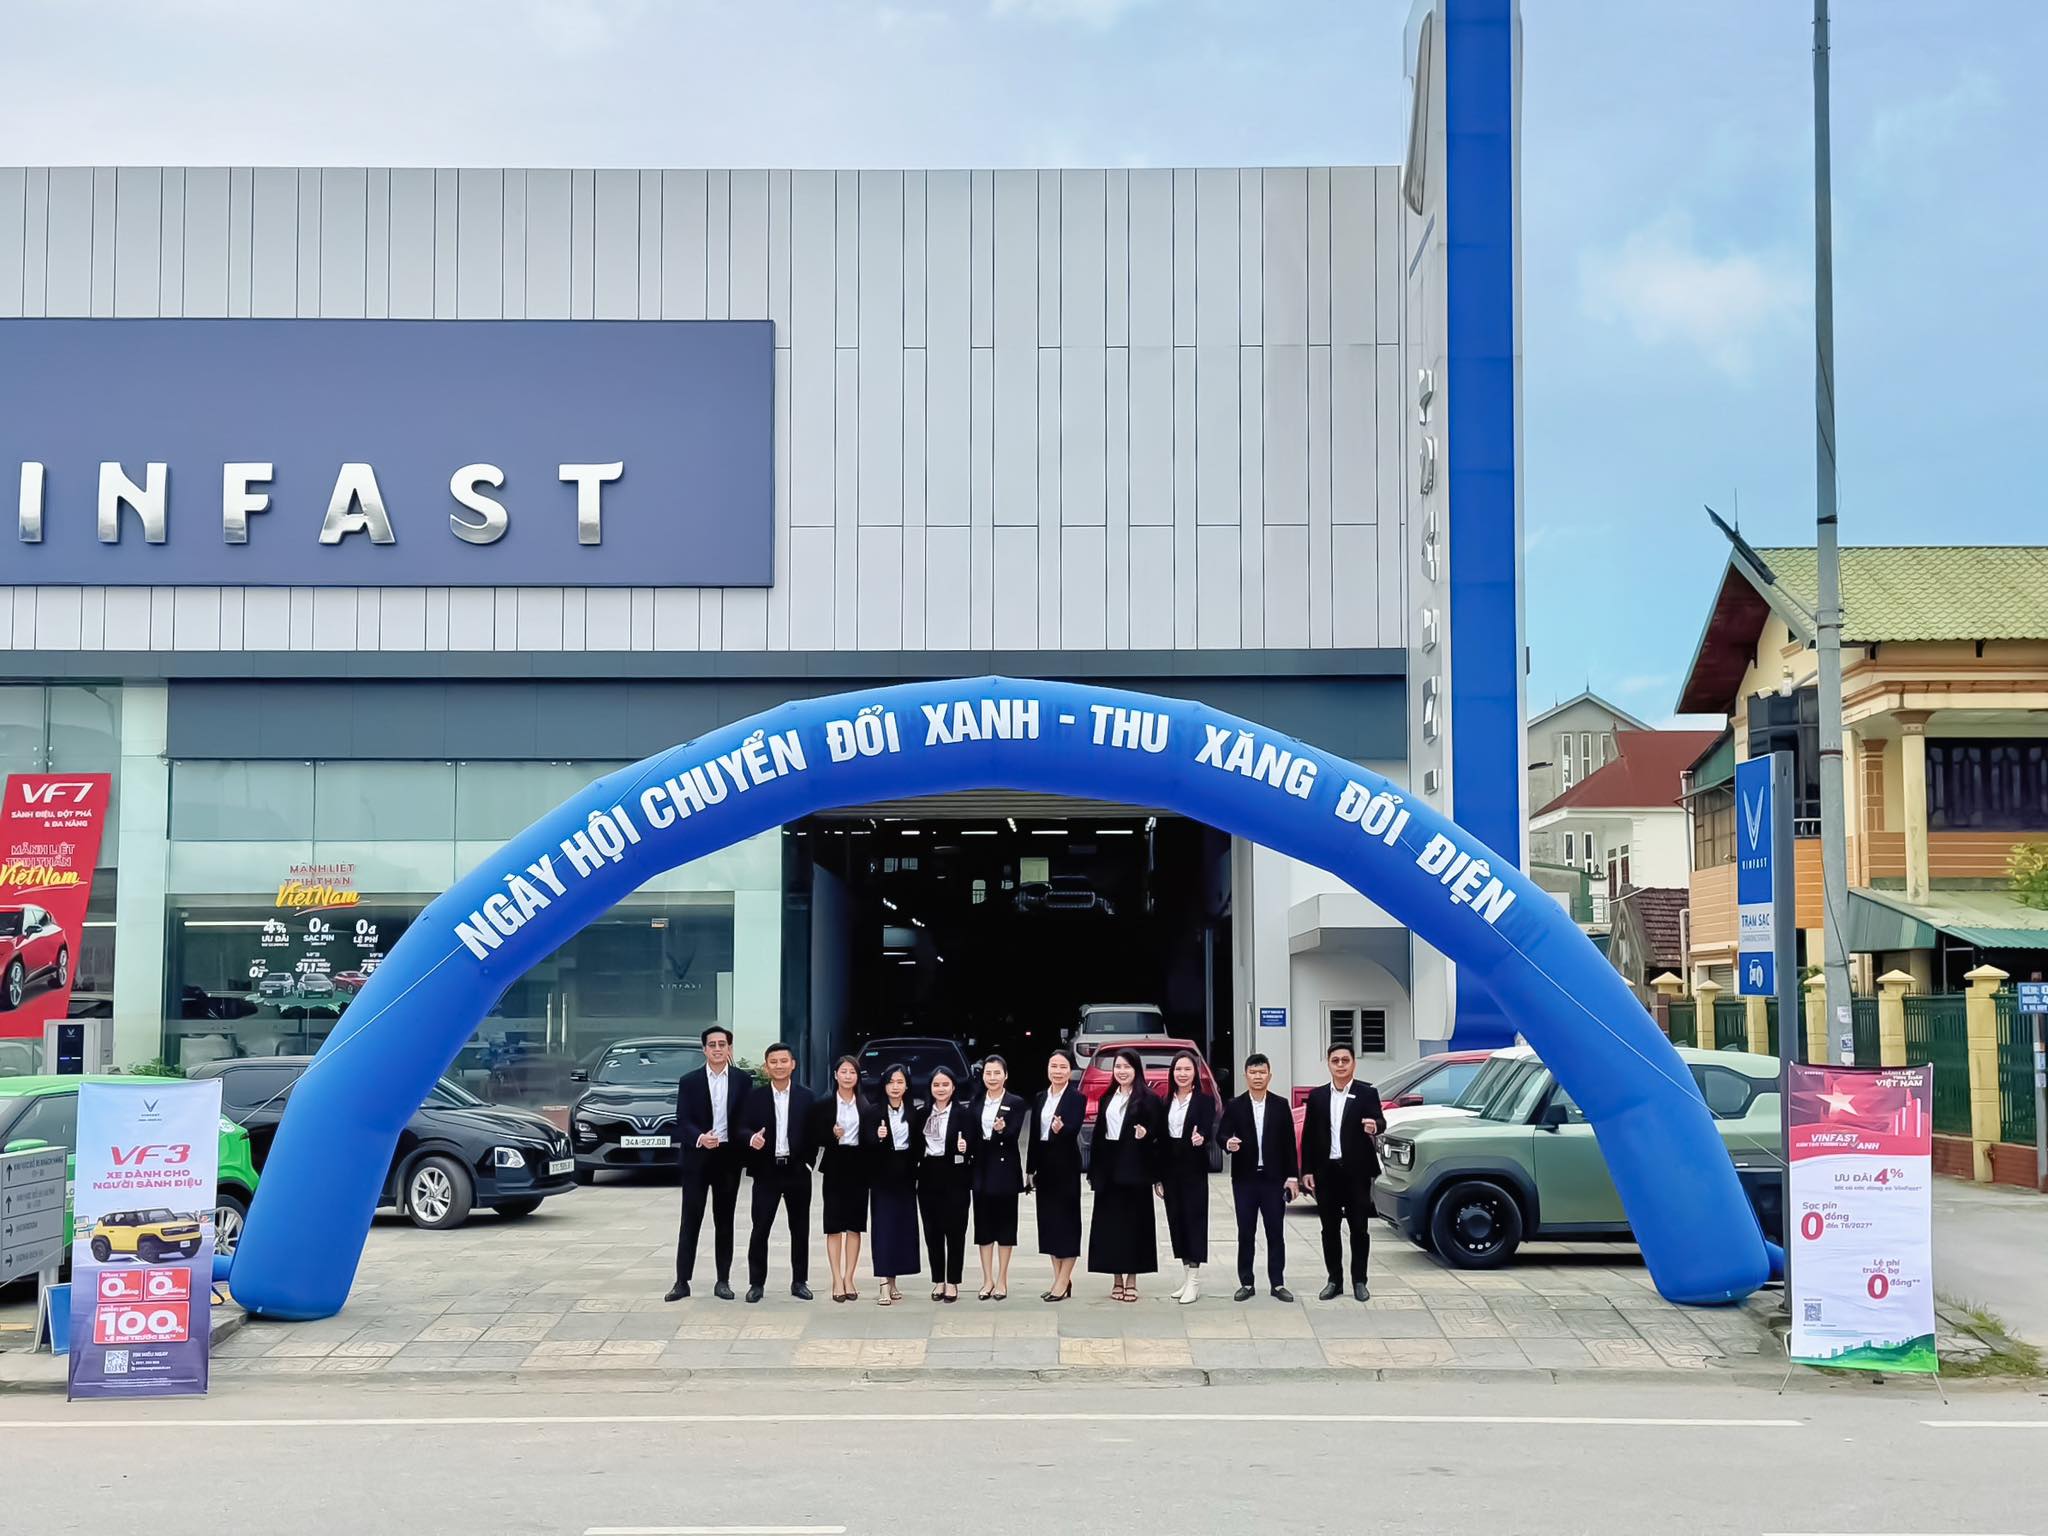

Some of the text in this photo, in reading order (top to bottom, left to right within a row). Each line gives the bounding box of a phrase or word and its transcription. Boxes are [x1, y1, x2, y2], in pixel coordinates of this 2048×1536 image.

[18, 460, 625, 546] INFAST
[453, 853, 569, 961] NGÀY
[560, 808, 643, 881] HỘI
[639, 728, 808, 831] CHUYỂN
[825, 703, 902, 764] ĐỔI
[919, 699, 1041, 748] XANH
[1089, 704, 1170, 755] THU
[1194, 723, 1319, 800] XĂNG
[1334, 779, 1412, 848] ĐỔI
[1414, 832, 1518, 925] ĐIỆN
[1900, 1079, 1923, 1087] NAM
[1811, 1134, 1859, 1143] VINFAST
[111, 1144, 191, 1166] VF3
[106, 1169, 190, 1179] XE DÀNH CHO
[1834, 1174, 1850, 1182] ƯU
[1874, 1168, 1904, 1185] 4%
[136, 1180, 172, 1189] SÀNH
[1822, 1203, 1837, 1211] pin
[1800, 1211, 1824, 1241] 0
[1867, 1274, 1889, 1300] 0
[99, 1309, 185, 1336] 100%
